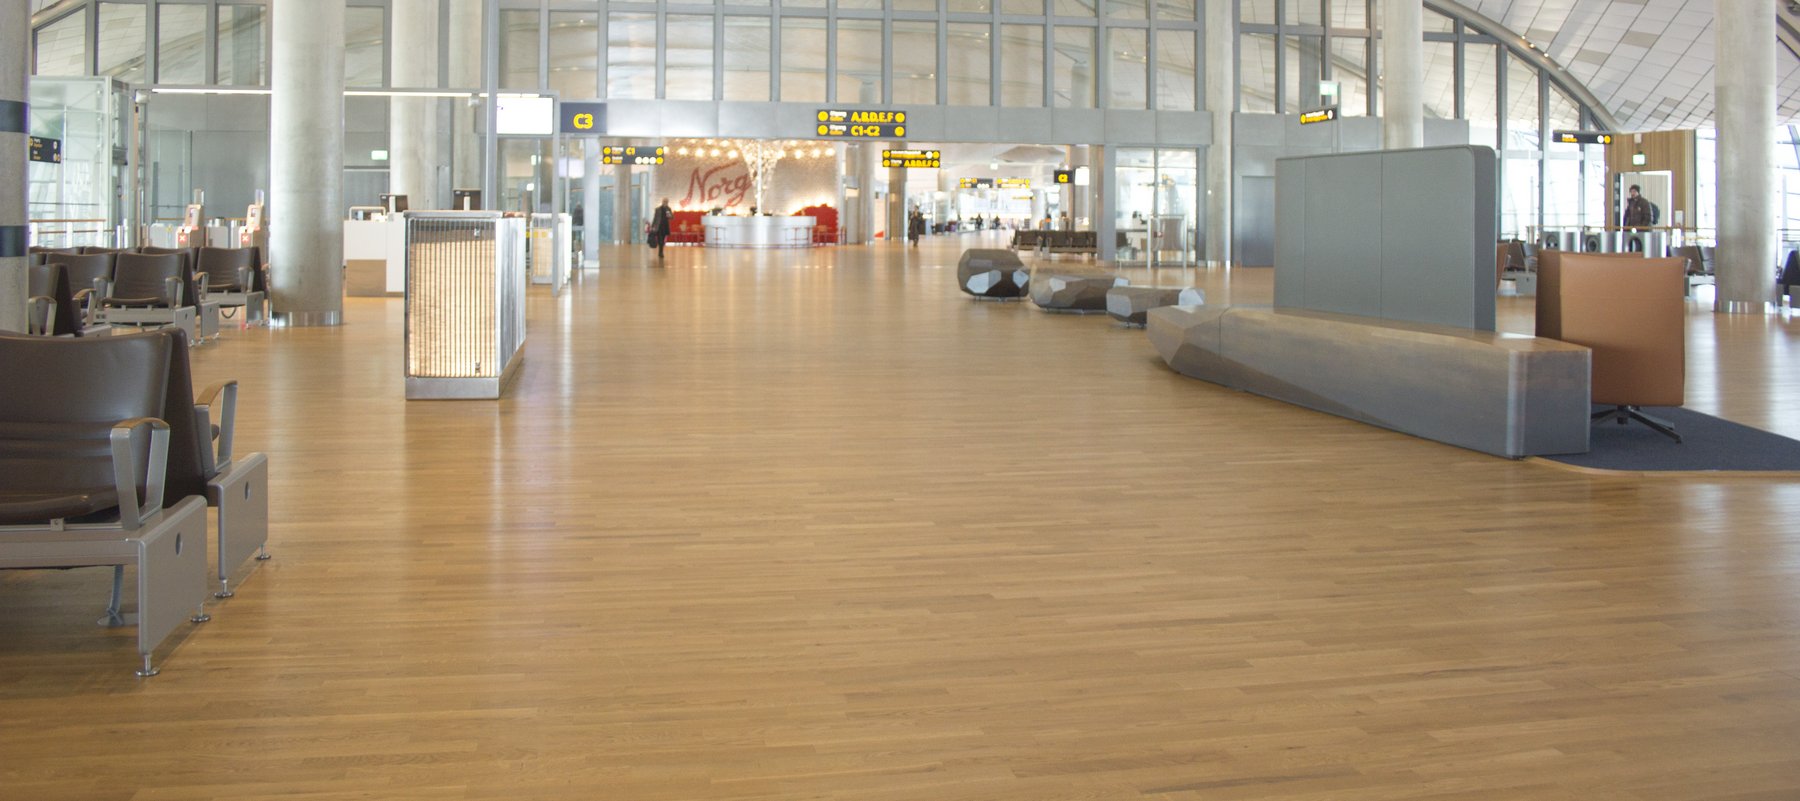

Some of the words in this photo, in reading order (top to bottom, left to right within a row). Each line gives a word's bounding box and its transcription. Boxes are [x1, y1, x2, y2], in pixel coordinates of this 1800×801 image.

[573, 113, 593, 129] C3
[851, 125, 880, 136] C1-C2
[680, 160, 754, 208] Norg
